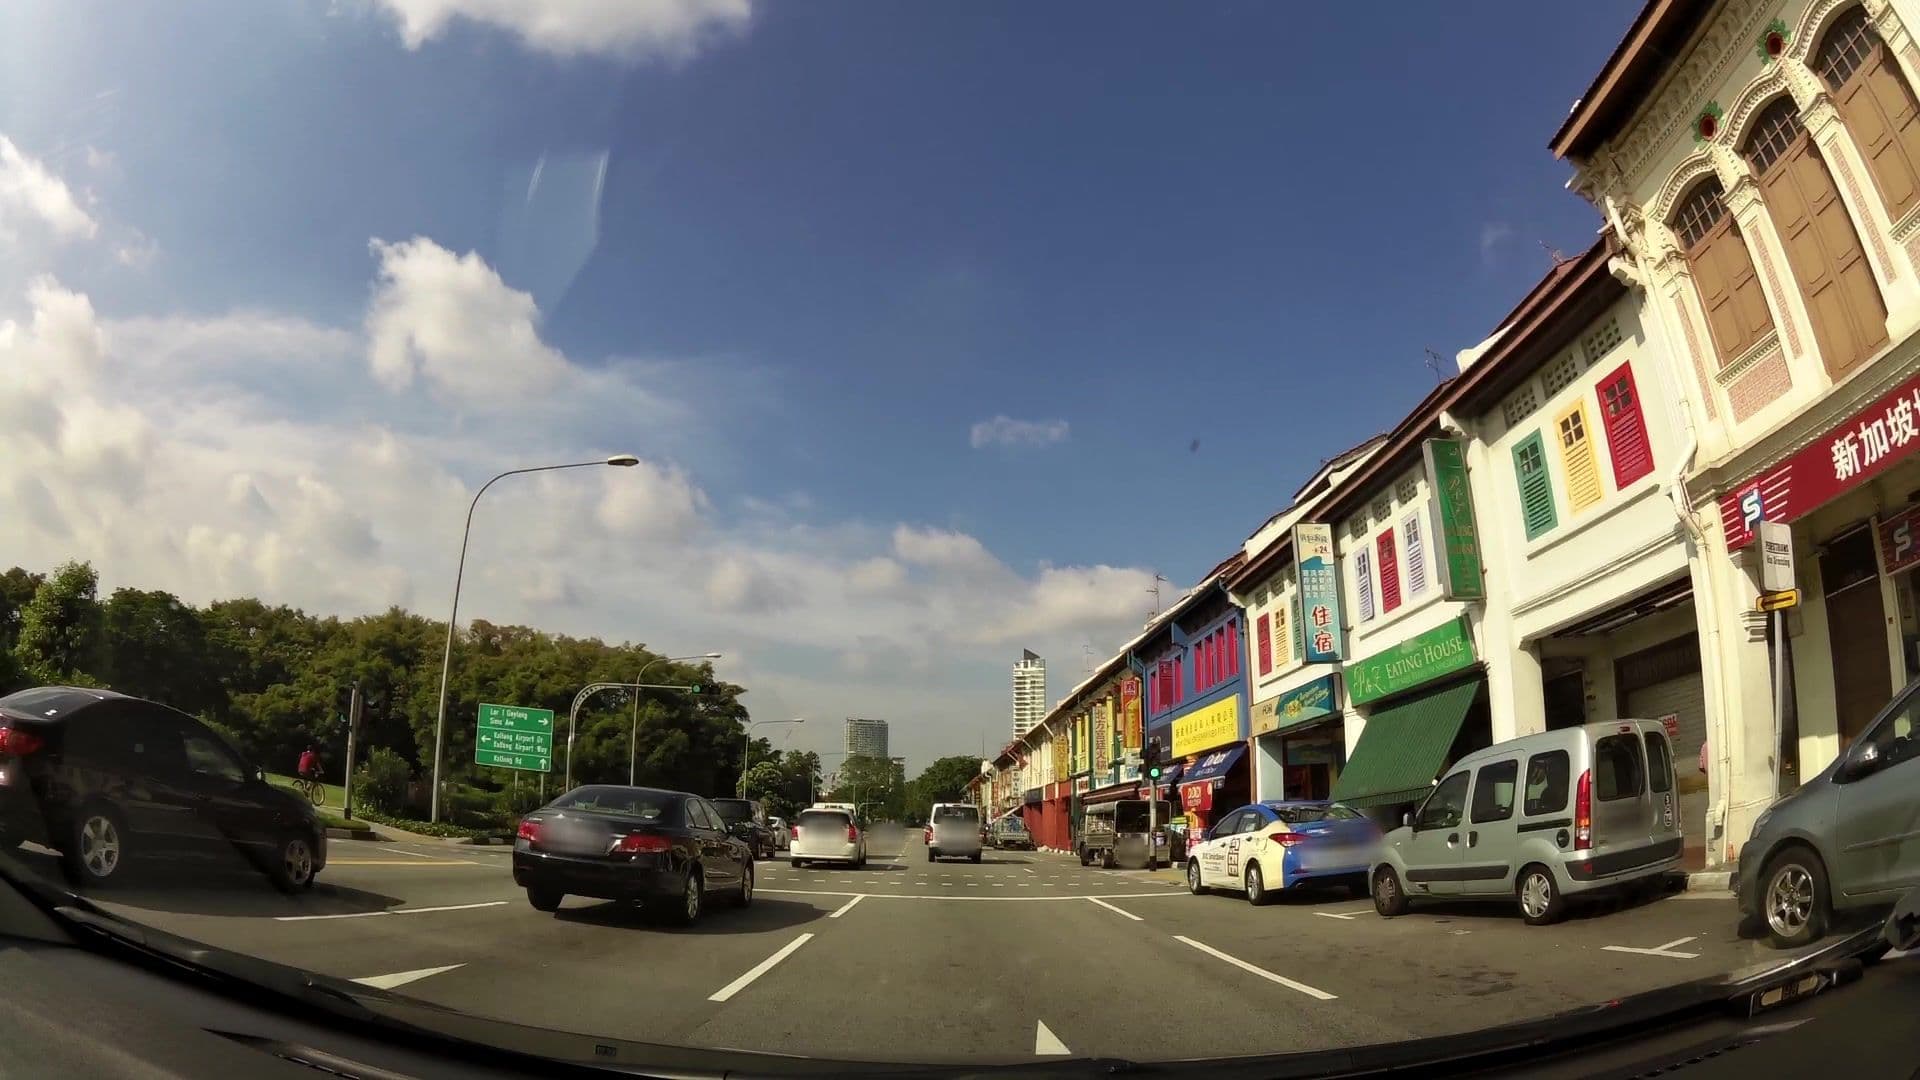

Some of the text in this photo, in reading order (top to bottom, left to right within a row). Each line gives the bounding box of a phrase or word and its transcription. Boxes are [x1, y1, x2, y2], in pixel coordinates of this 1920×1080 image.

[1311, 604, 1333, 654] 住宿
[1385, 653, 1422, 679] EATING
[1423, 637, 1464, 665] HOUSE
[493, 732, 513, 742] Kallang
[515, 734, 534, 744] Airport
[493, 741, 513, 751] Kallang
[515, 743, 534, 753] Airport
[493, 755, 513, 765] Kallang
